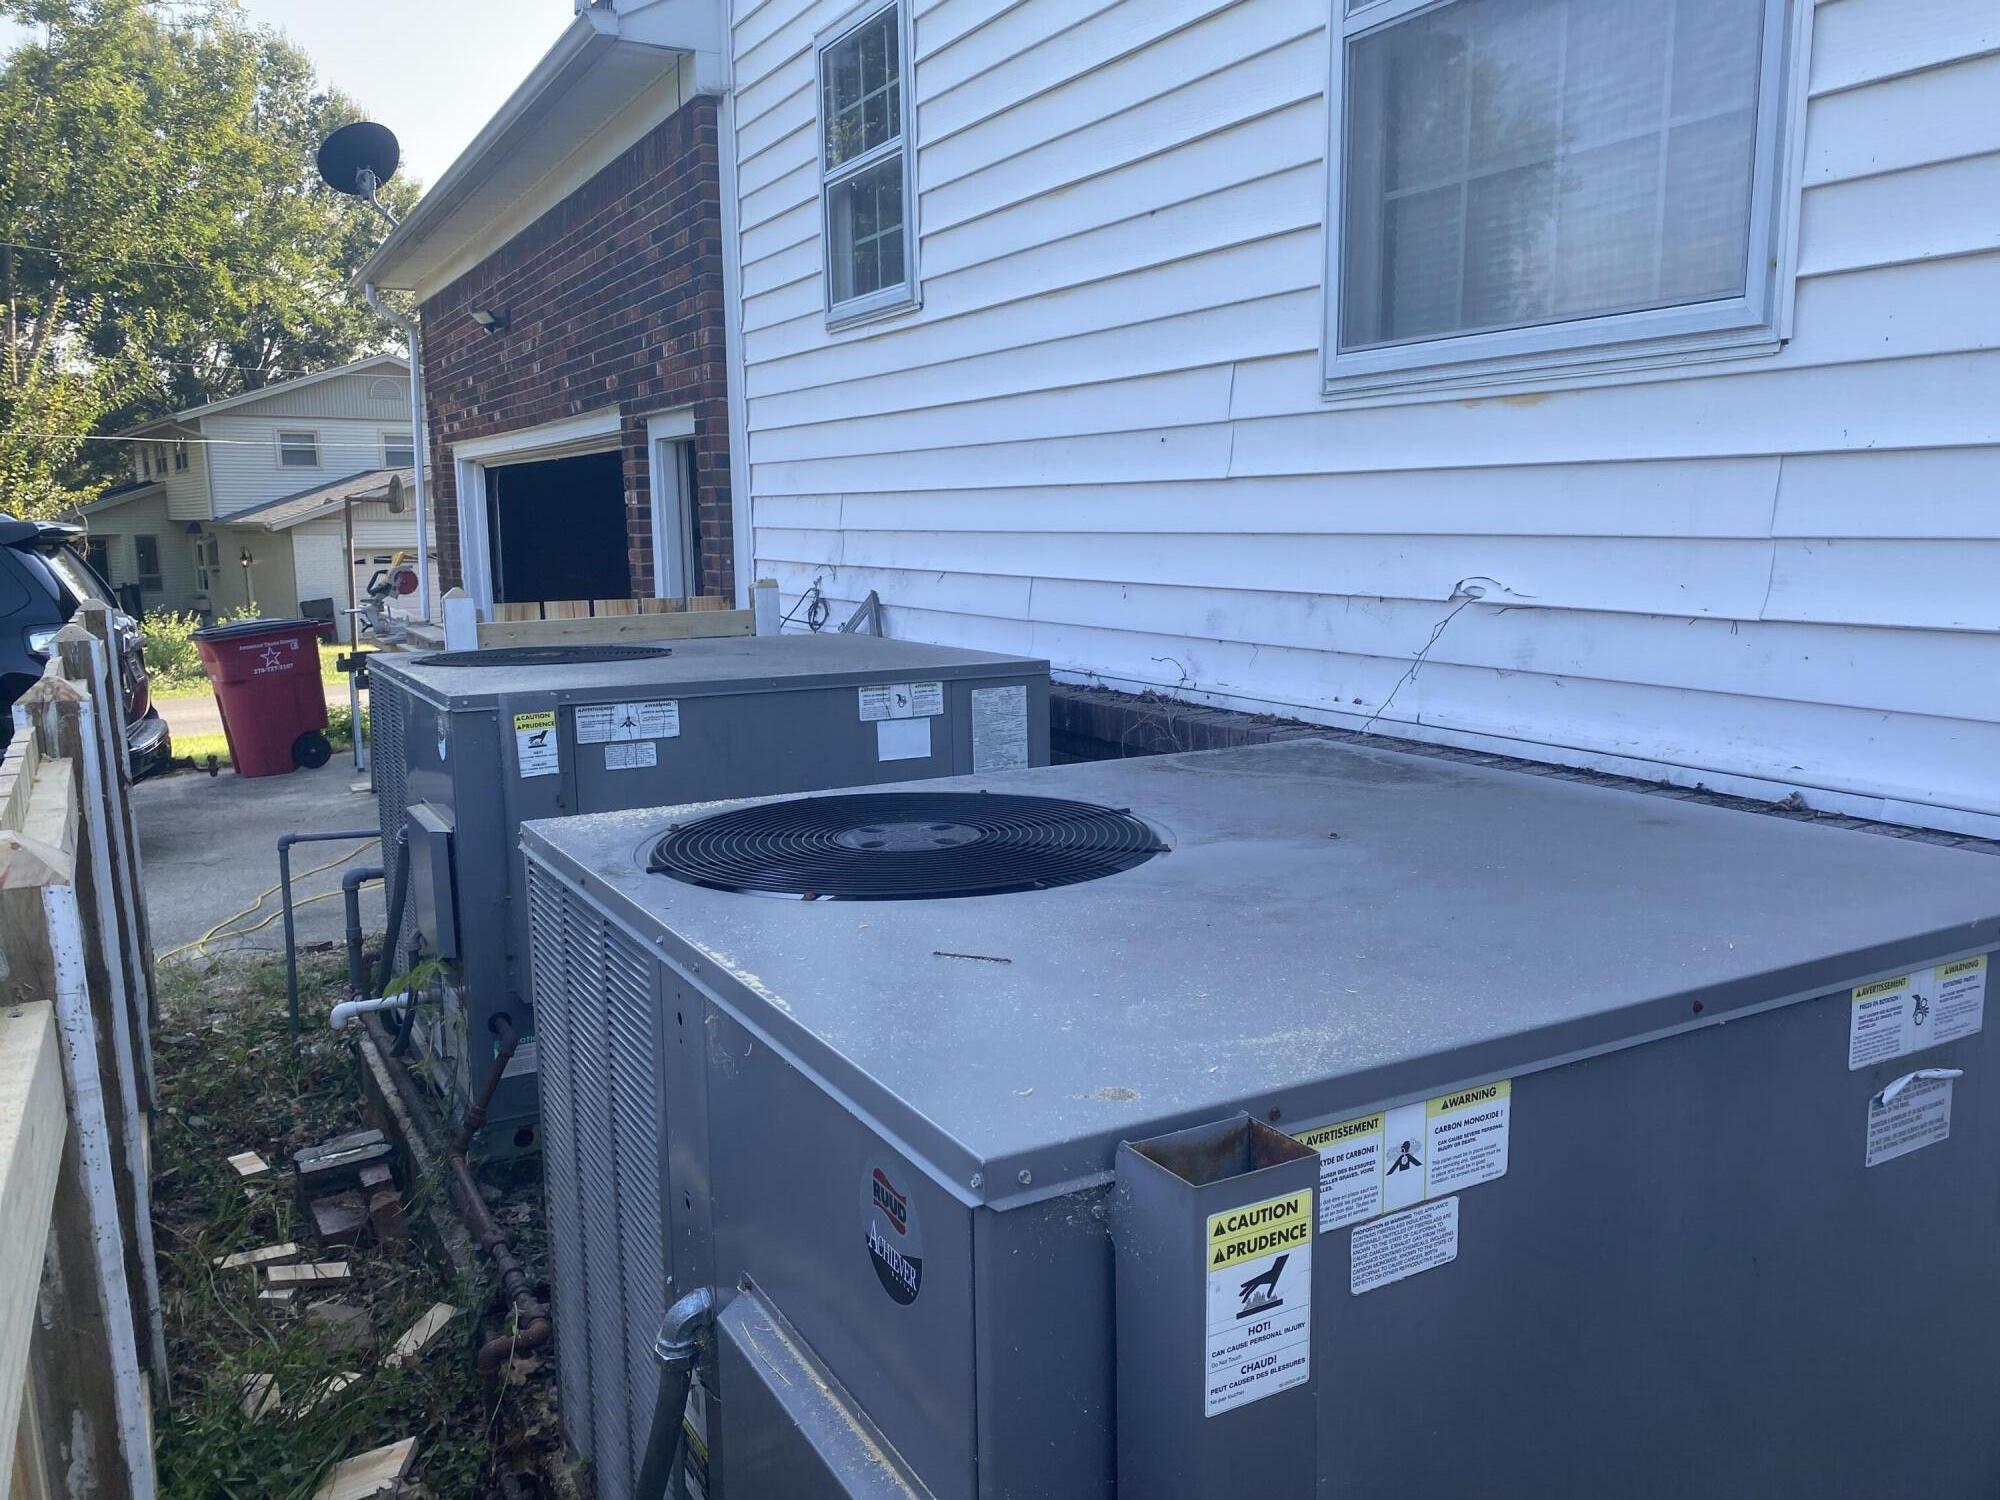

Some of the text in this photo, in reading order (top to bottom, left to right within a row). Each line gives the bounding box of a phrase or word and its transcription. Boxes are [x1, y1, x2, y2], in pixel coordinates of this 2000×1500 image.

[521, 713, 550, 721] CAUTION
[522, 721, 554, 729] PRUDENCE
[1862, 977, 1906, 996] AVERTISSEMENT
[1447, 1087, 1497, 1109] WARNING
[1306, 1118, 1379, 1147] AVERTISSEMENT
[1435, 1121, 1462, 1135] CARBON
[1464, 1111, 1498, 1127] MONOXIDE
[1448, 1135, 1463, 1144] CAUSE
[1464, 1130, 1480, 1139] SEVERE
[1482, 1123, 1503, 1134] PERSONAL
[1337, 1154, 1344, 1163] DE
[1346, 1146, 1374, 1161] CARBONE
[1438, 1144, 1453, 1153] INJURY
[1349, 1160, 1376, 1172] BLESSURES
[873, 1179, 906, 1224] RUUD
[1227, 1199, 1298, 1232] CAUTION
[1226, 1223, 1307, 1260] PRUDENCE
[868, 1219, 917, 1291] ACHIEVER
[1248, 1321, 1271, 1336] HOT!
[1211, 1322, 1306, 1358] CAN CAUSE PERSONAL INJURY
[1240, 1355, 1277, 1375] CHAUD!
[1210, 1357, 1306, 1396] PEUT CAUSER DES BLESSURES
